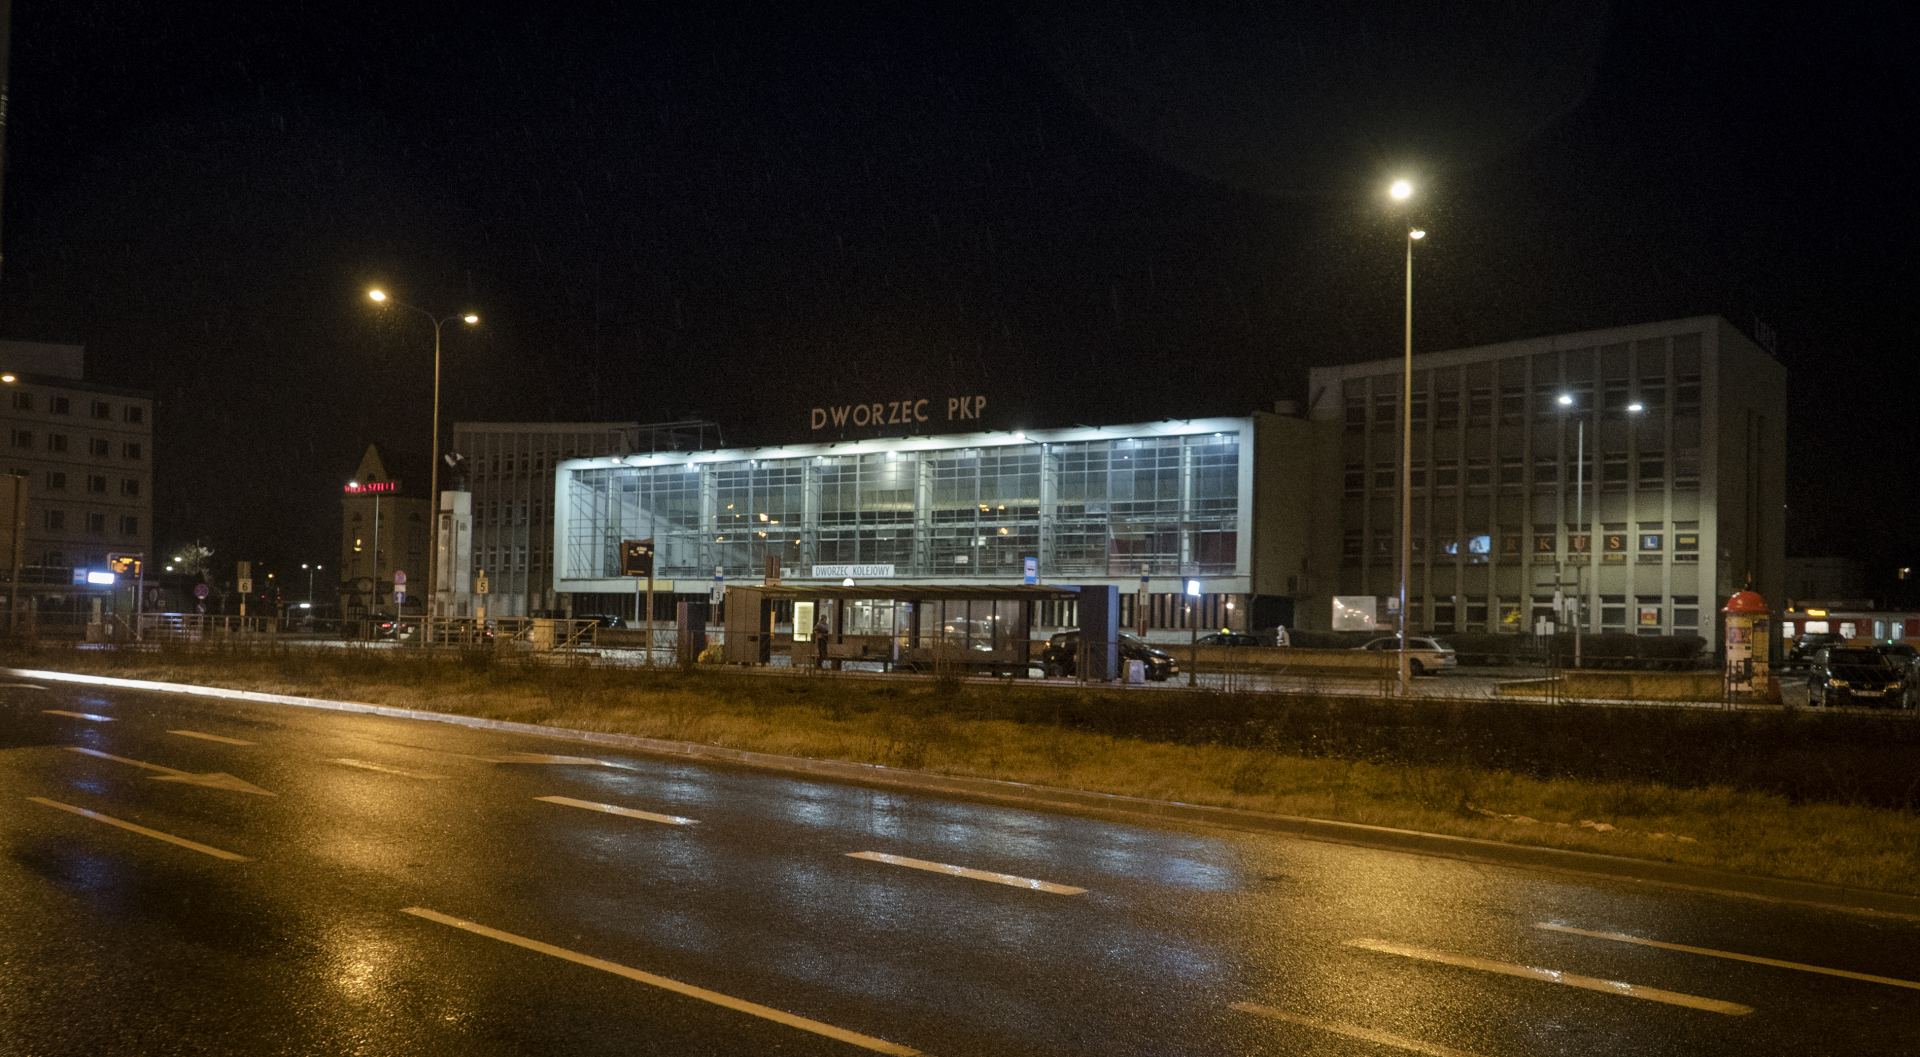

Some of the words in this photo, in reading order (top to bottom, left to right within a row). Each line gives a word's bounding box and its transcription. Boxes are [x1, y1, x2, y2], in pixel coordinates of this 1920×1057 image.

[811, 399, 928, 430] DWORZEC
[948, 395, 987, 420] PKP
[815, 566, 848, 576] DWORZEC
[852, 565, 890, 576] KOLEJOWY
[242, 582, 248, 591] 6
[480, 582, 486, 592] 5
[715, 591, 720, 599] 3
